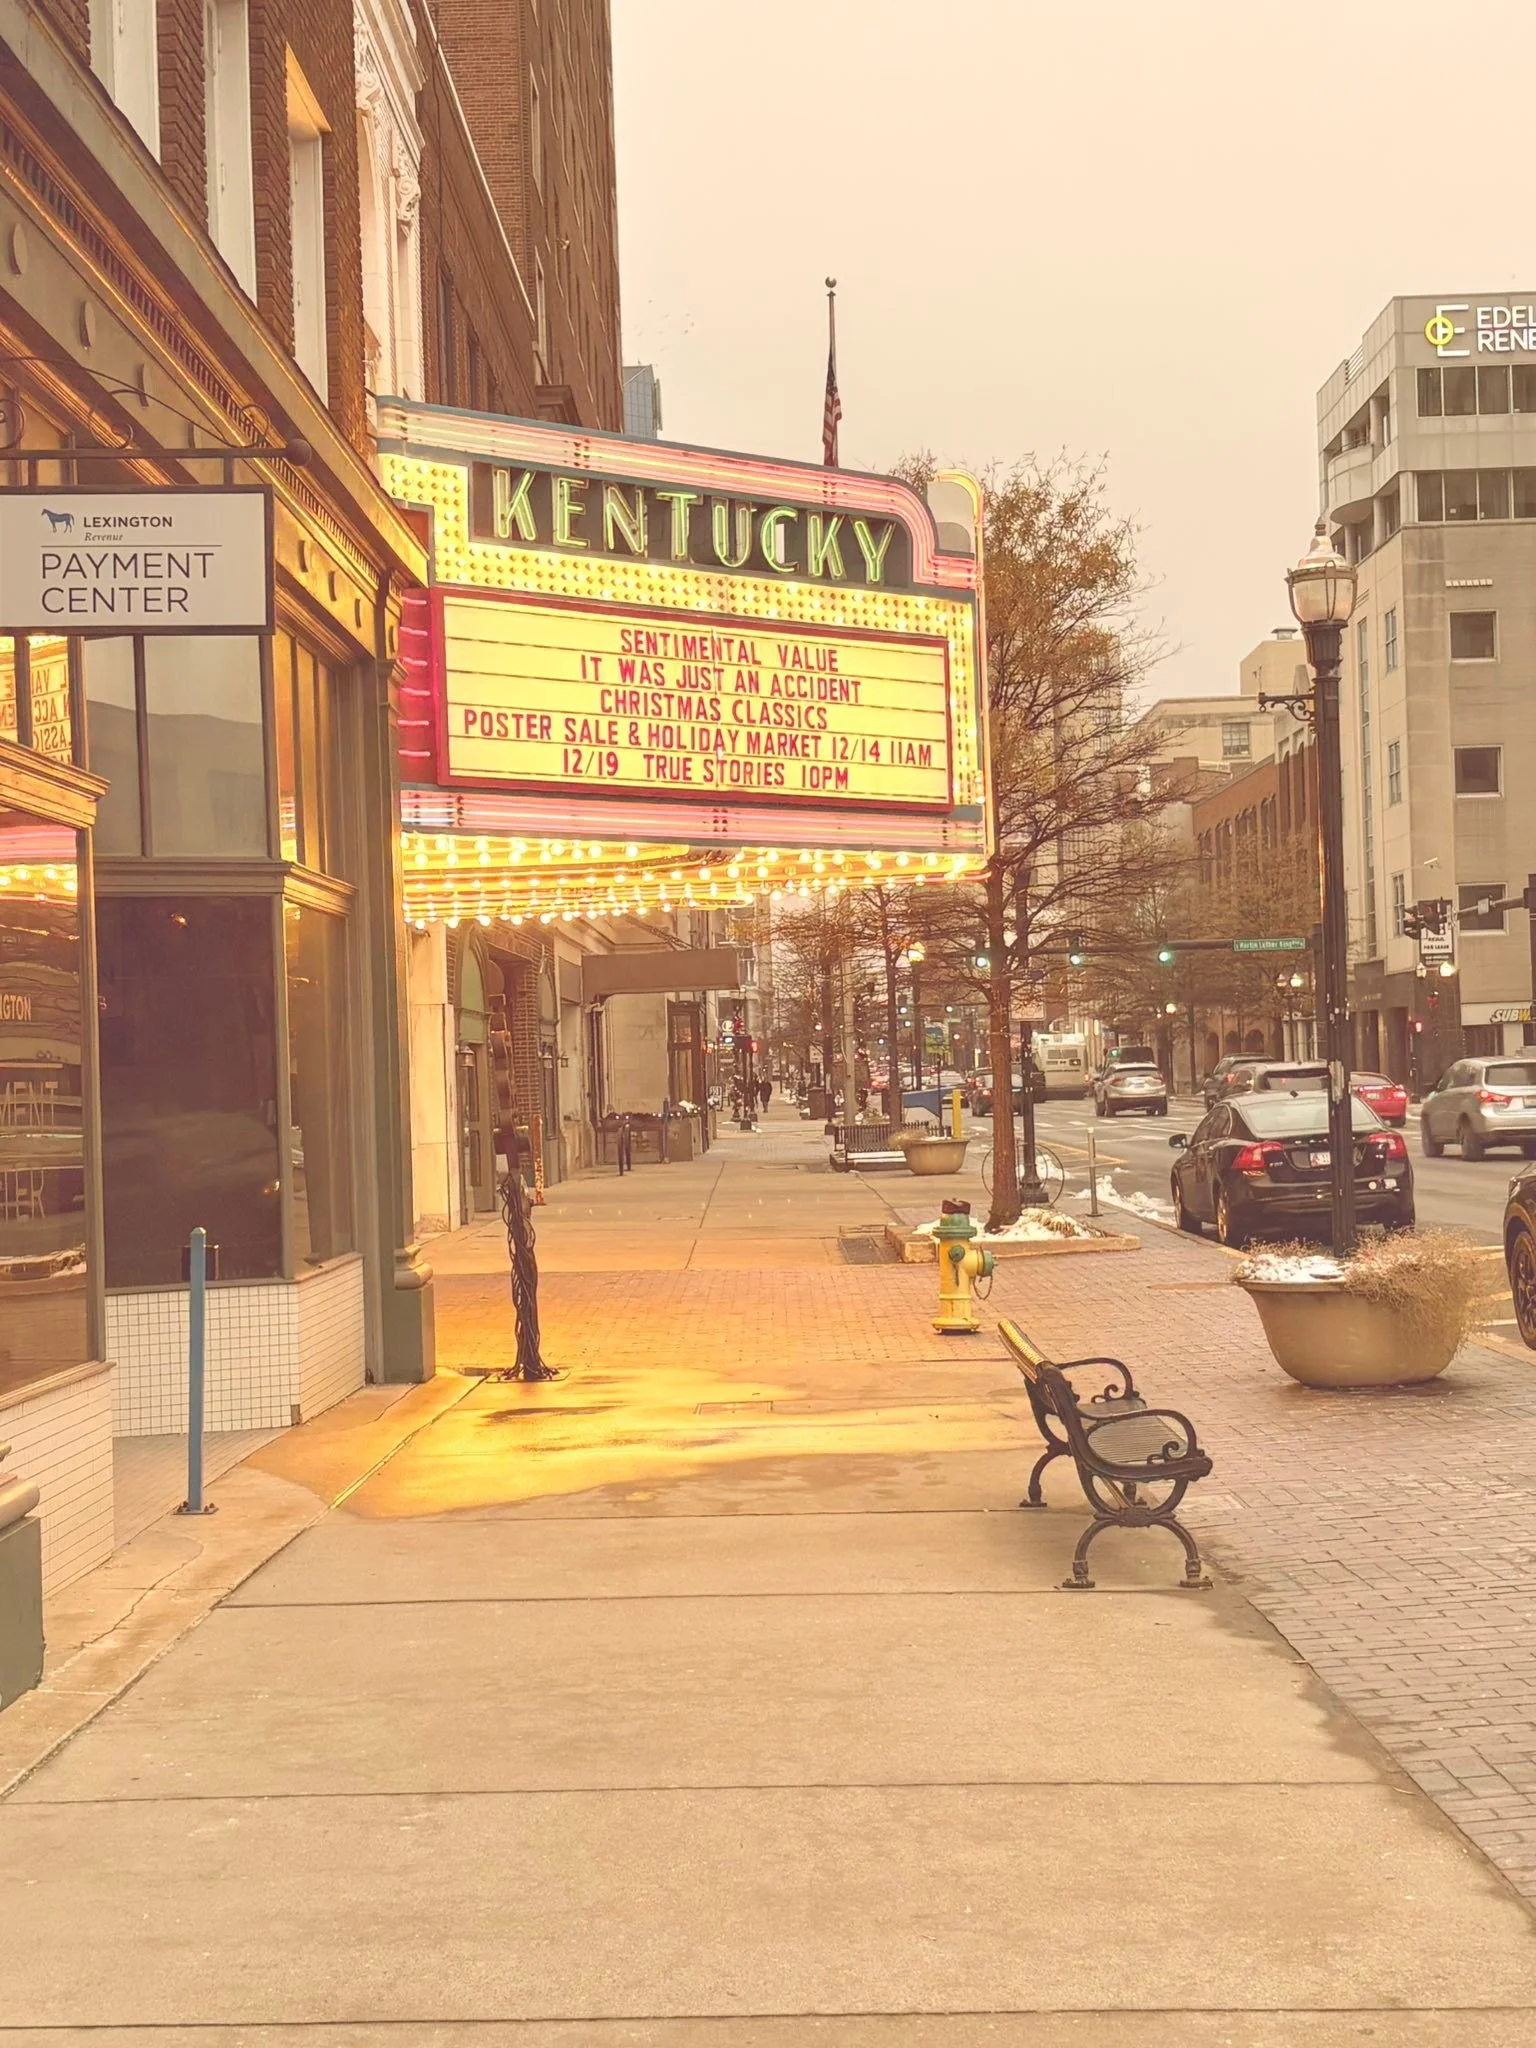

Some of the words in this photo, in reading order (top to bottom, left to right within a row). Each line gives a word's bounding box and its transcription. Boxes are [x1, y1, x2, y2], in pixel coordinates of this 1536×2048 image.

[83, 516, 173, 528] LEXINGTON
[84, 532, 124, 542] Revenue
[491, 463, 897, 586] KENTUCKY
[42, 552, 215, 580] PAYMENT
[41, 587, 189, 614] CENTER
[620, 628, 762, 666] SENTIMENTAL
[777, 643, 839, 673] VALUE
[580, 654, 602, 682] IT
[618, 658, 665, 687] WAS
[676, 664, 725, 692] JUST
[734, 669, 760, 694] AN
[770, 673, 861, 704] ACCIDENT
[600, 688, 721, 722] CHRISTMAS
[731, 699, 828, 730] CLASSICS
[464, 708, 552, 741] POSTER
[564, 717, 619, 746] SALE
[628, 721, 642, 747] &
[647, 722, 739, 753] HOLIDAY
[746, 731, 822, 759] MARKET
[831, 736, 881, 763] 12/14
[890, 740, 932, 768] 11AM
[562, 748, 619, 777] 12/19
[643, 754, 693, 782] TRUE
[703, 757, 785, 787] STORIES
[801, 764, 849, 790] 10PM
